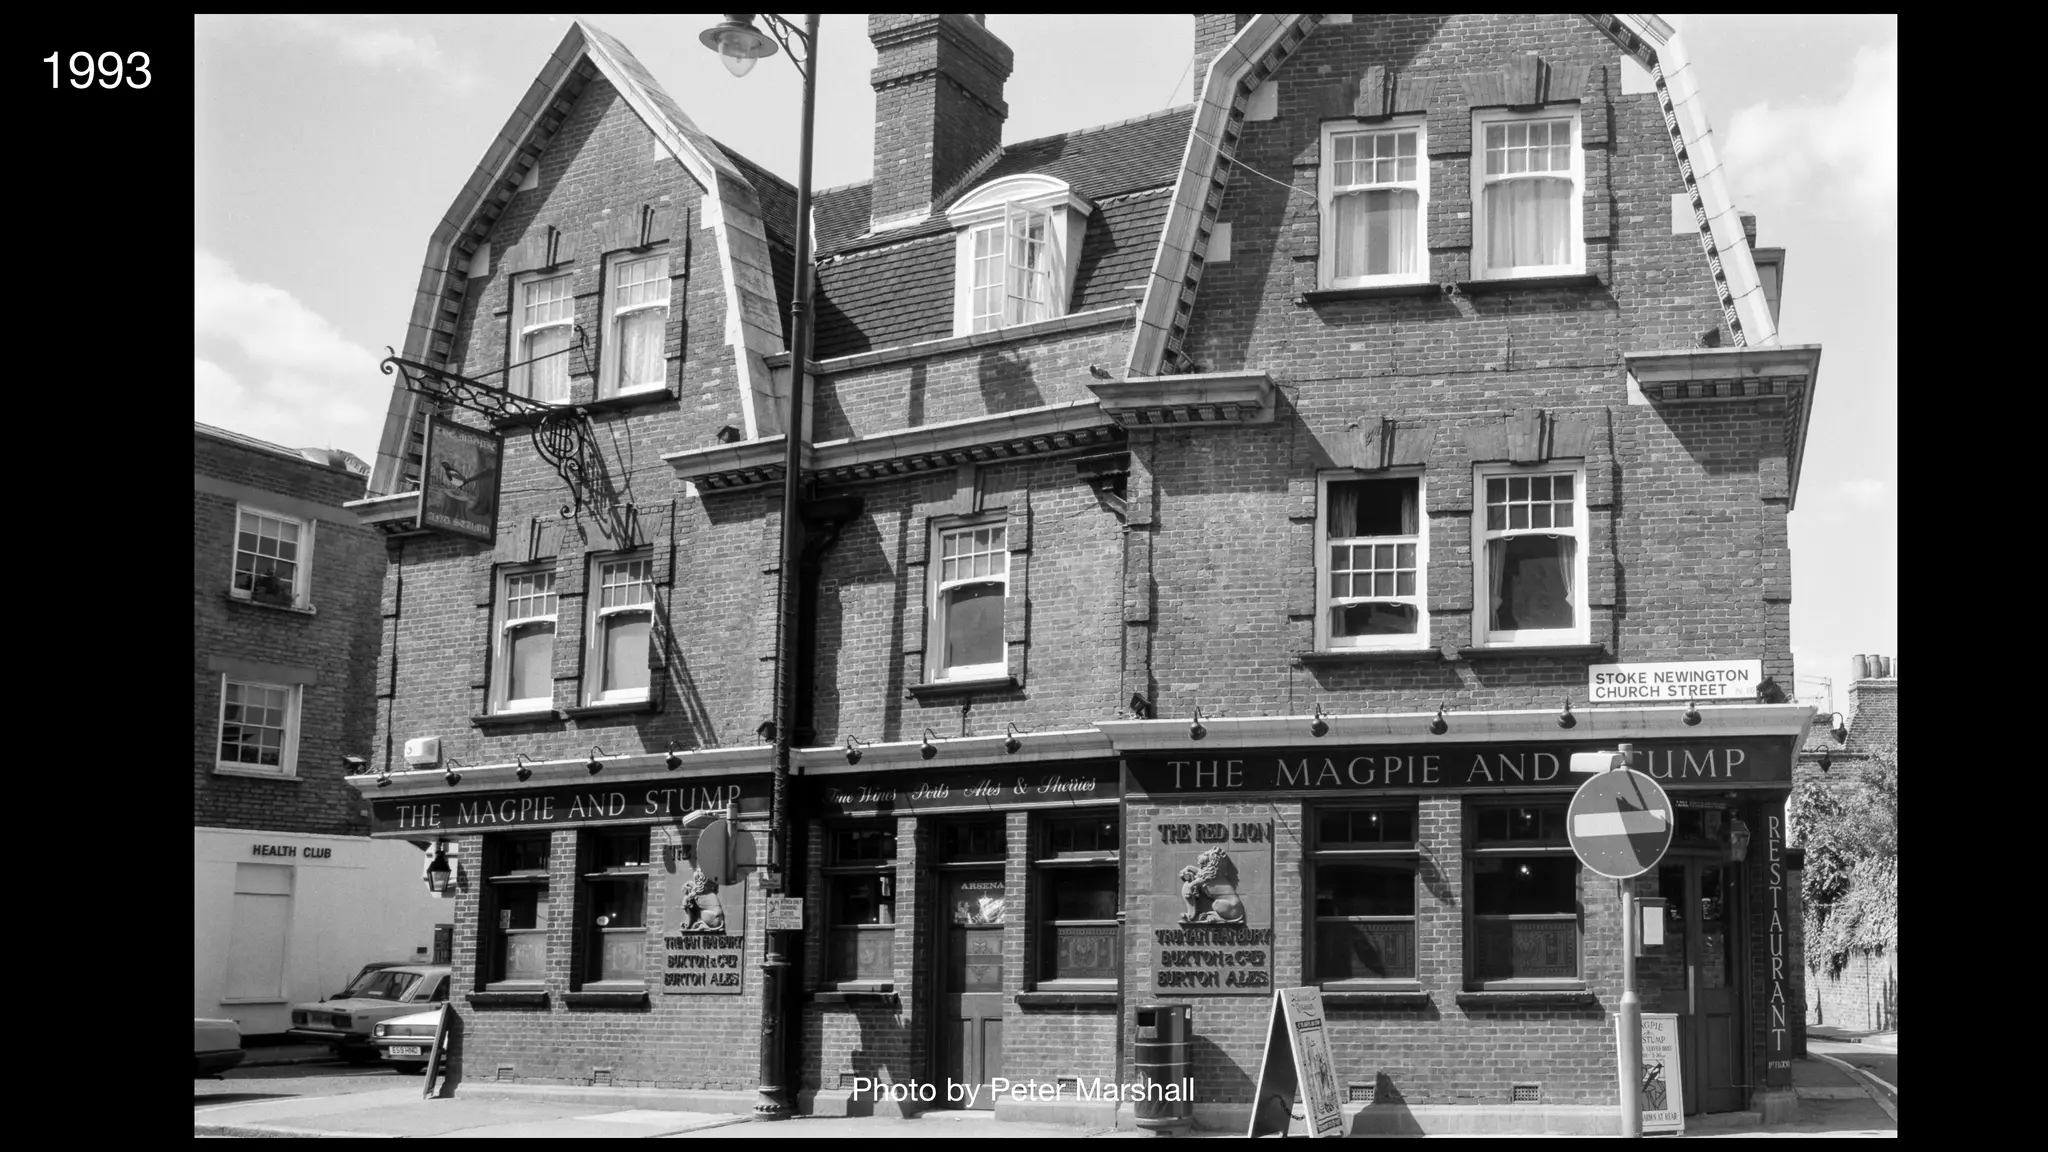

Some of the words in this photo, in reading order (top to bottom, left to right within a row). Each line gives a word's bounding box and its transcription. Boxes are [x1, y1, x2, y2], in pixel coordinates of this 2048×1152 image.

[1596, 672, 1647, 685] STOKE
[1654, 669, 1749, 684] NEWINGTON
[1596, 685, 1660, 699] CHURCH
[1667, 683, 1727, 697] STREET
[1167, 760, 1244, 788] THE
[1275, 755, 1441, 787] MAGPIE
[1466, 753, 1560, 782] AND
[963, 779, 1001, 798] Ales
[1013, 777, 1028, 796] &
[396, 803, 442, 829] THE
[457, 796, 555, 825] MAGPIE
[567, 792, 626, 819] AND
[645, 784, 741, 815] STUMP
[1157, 823, 1192, 844] THE
[1195, 823, 1230, 843] RED
[1232, 822, 1272, 843] LION
[252, 844, 297, 857] HEALTH
[303, 847, 332, 859] CLUB
[960, 882, 1005, 890] ARSENA
[1768, 816, 1786, 1051] RESTAURANT
[710, 972, 740, 987] ALES
[1157, 971, 1220, 988] BURTON
[1225, 971, 1270, 988] ALES
[1643, 1021, 1664, 1032] GPIE
